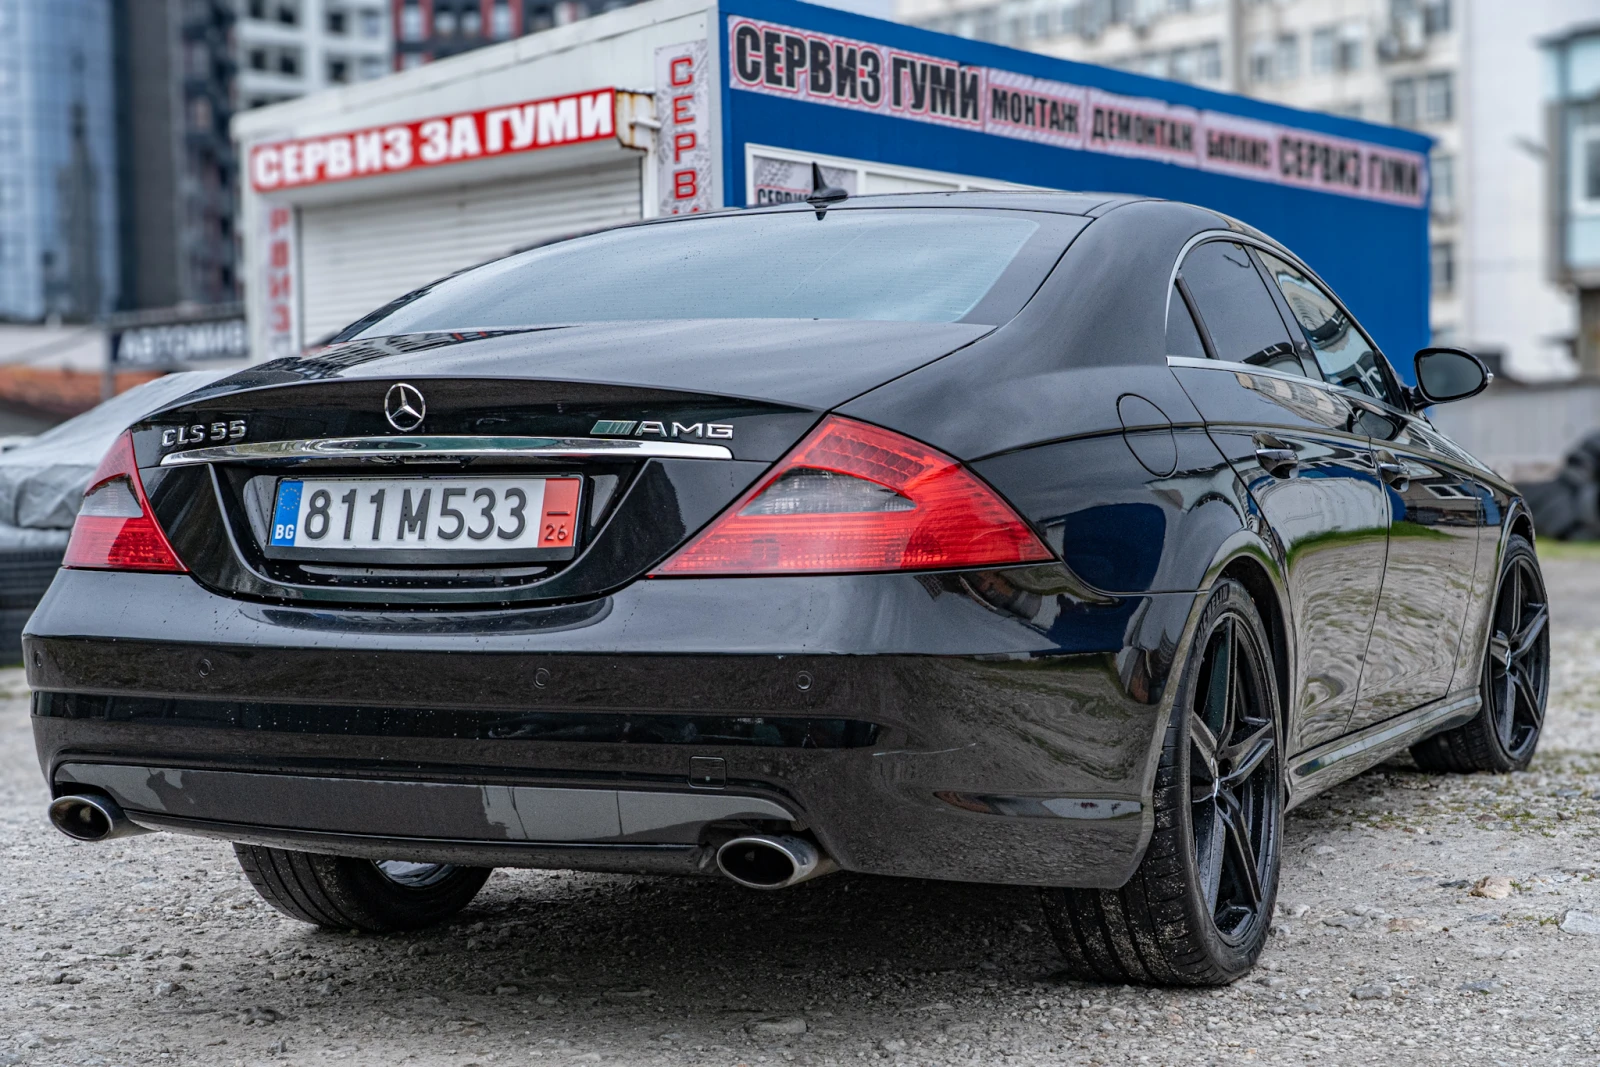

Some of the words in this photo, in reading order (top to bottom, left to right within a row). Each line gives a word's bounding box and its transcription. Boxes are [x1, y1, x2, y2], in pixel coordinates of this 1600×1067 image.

[735, 25, 882, 104] СЕРВИЗ
[891, 56, 980, 122] ГУМИ
[991, 87, 1079, 134] МОНТАЖ
[1279, 135, 1361, 187] СЕРВИЗ
[254, 126, 413, 189] СЕРВИЗ
[420, 114, 483, 164] ЗА
[486, 92, 613, 153] ГУМИ
[669, 57, 698, 214] СЕРВ
[162, 424, 206, 447] CLS
[209, 420, 247, 441] 55
[634, 420, 734, 440] AMG
[275, 524, 295, 540] BG
[304, 487, 529, 541] 811M533
[544, 522, 569, 541] 26
